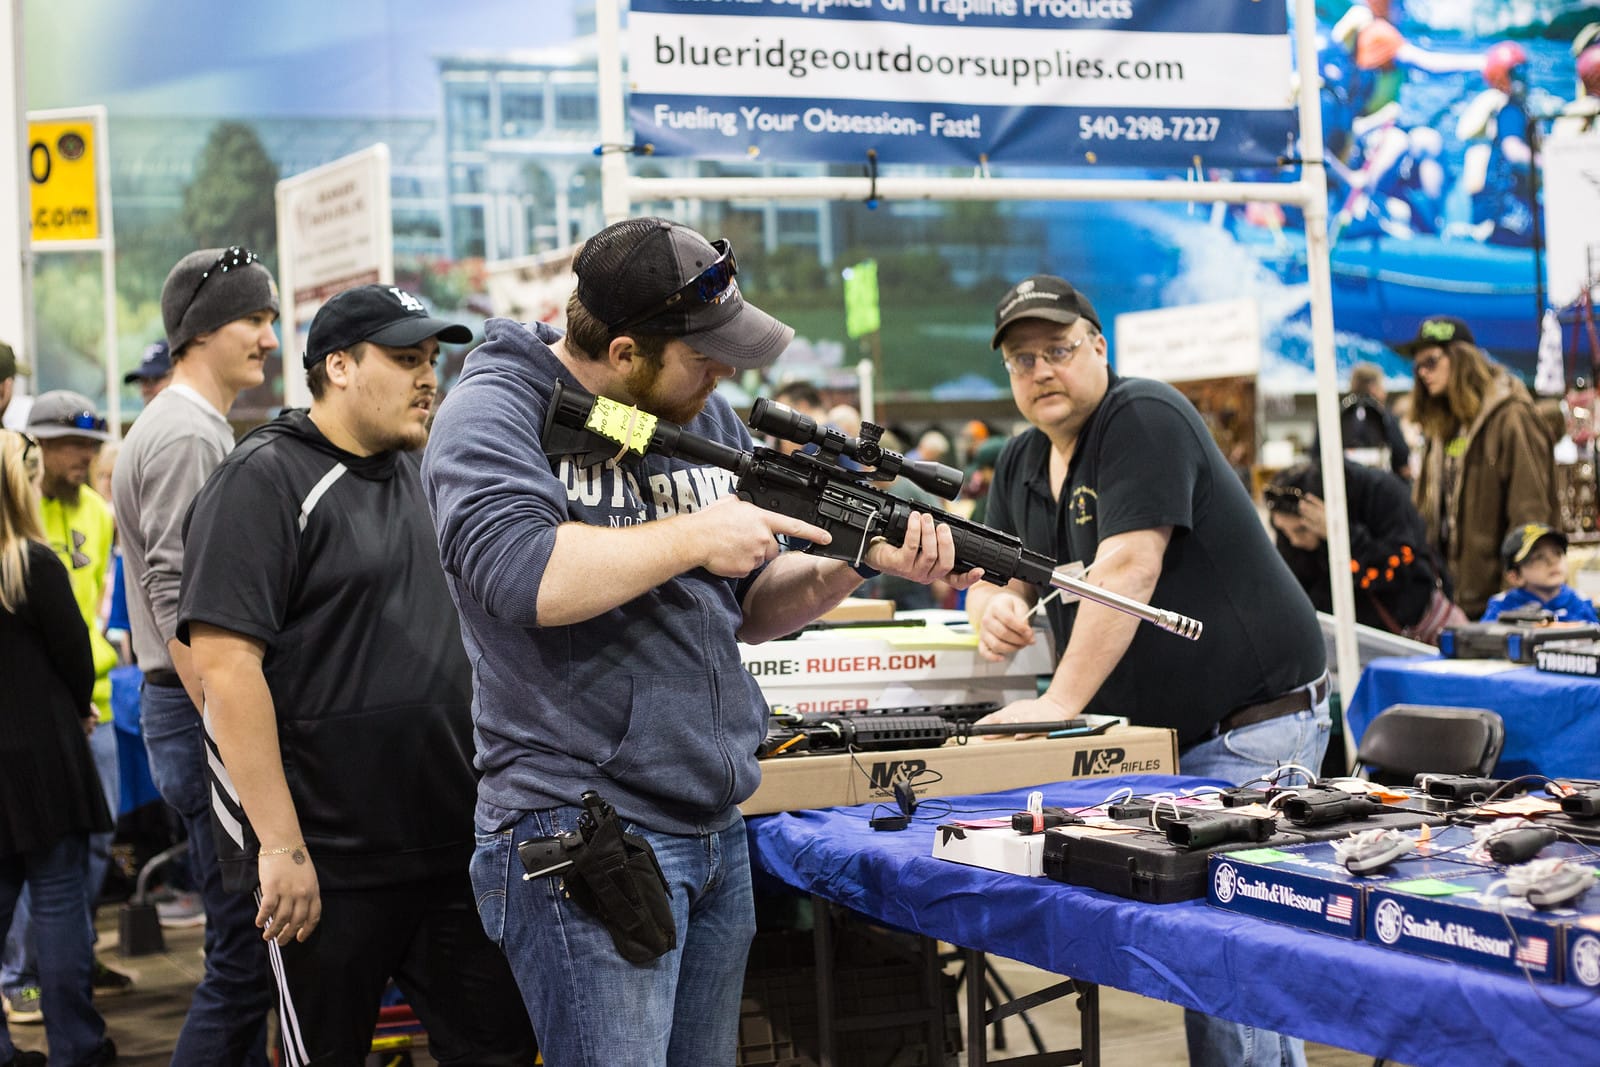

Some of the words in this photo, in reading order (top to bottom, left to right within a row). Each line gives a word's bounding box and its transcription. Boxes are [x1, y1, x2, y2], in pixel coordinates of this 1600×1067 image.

[769, 0, 873, 14] pper
[1023, 0, 1134, 19] Products
[654, 35, 1185, 86] blueridgeoutdoorsupplies.com
[654, 104, 738, 136] Fueling
[740, 106, 799, 132] Your
[803, 107, 925, 137] Obsession-
[930, 112, 981, 138] Fast!
[1079, 115, 1220, 141] 540-298-7227
[648, 466, 740, 522] BANK
[742, 660, 799, 677] ORE:
[806, 654, 936, 674] RUGER.COM
[1537, 651, 1598, 675] TAURUS
[869, 759, 927, 790] M&P
[1071, 747, 1126, 777] M&P
[1120, 759, 1161, 773] RIFLES
